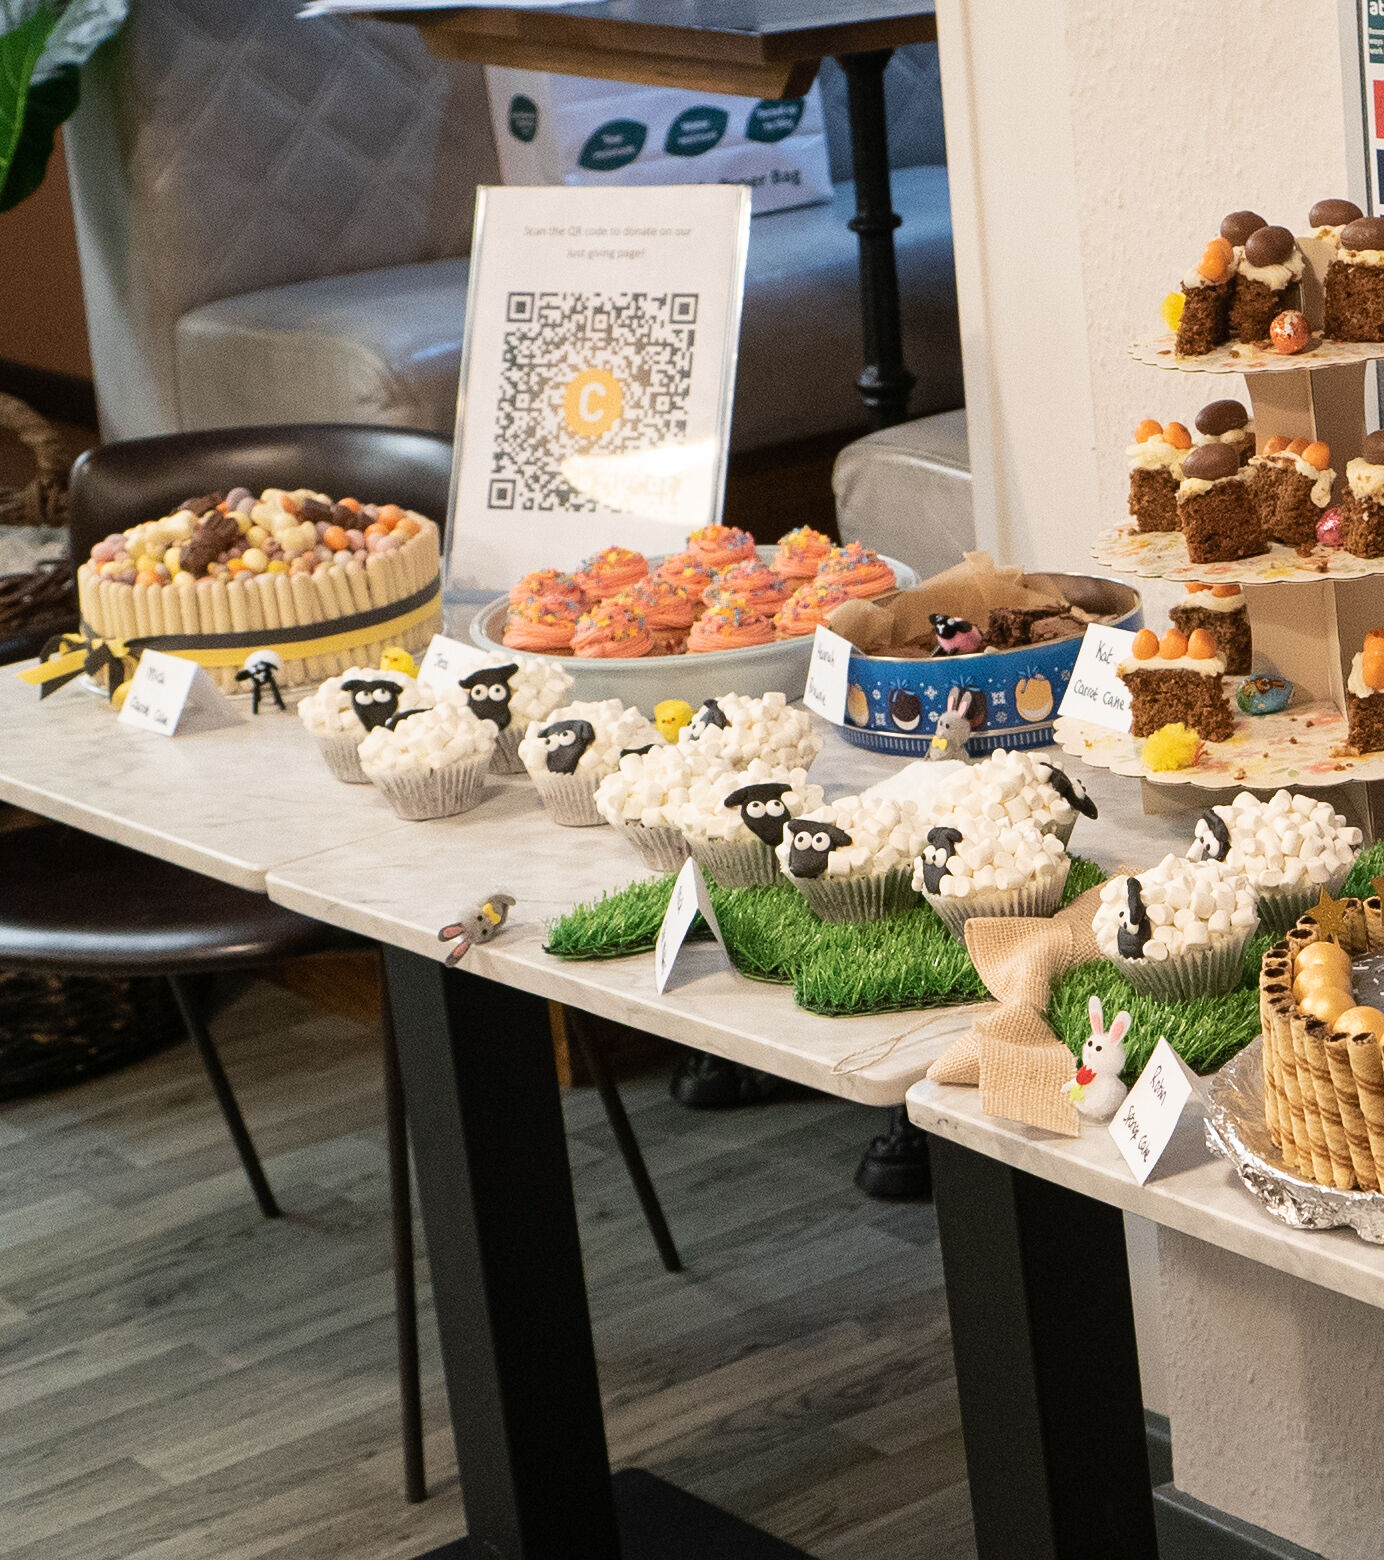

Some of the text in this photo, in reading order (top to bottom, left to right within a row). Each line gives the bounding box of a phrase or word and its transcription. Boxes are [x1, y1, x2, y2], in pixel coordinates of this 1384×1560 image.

[1369, 0, 1384, 16] at
[525, 226, 692, 236] Scan the QR code to donate on our
[588, 249, 615, 260] giving
[579, 381, 606, 423] C
[1096, 640, 1113, 664] Kat
